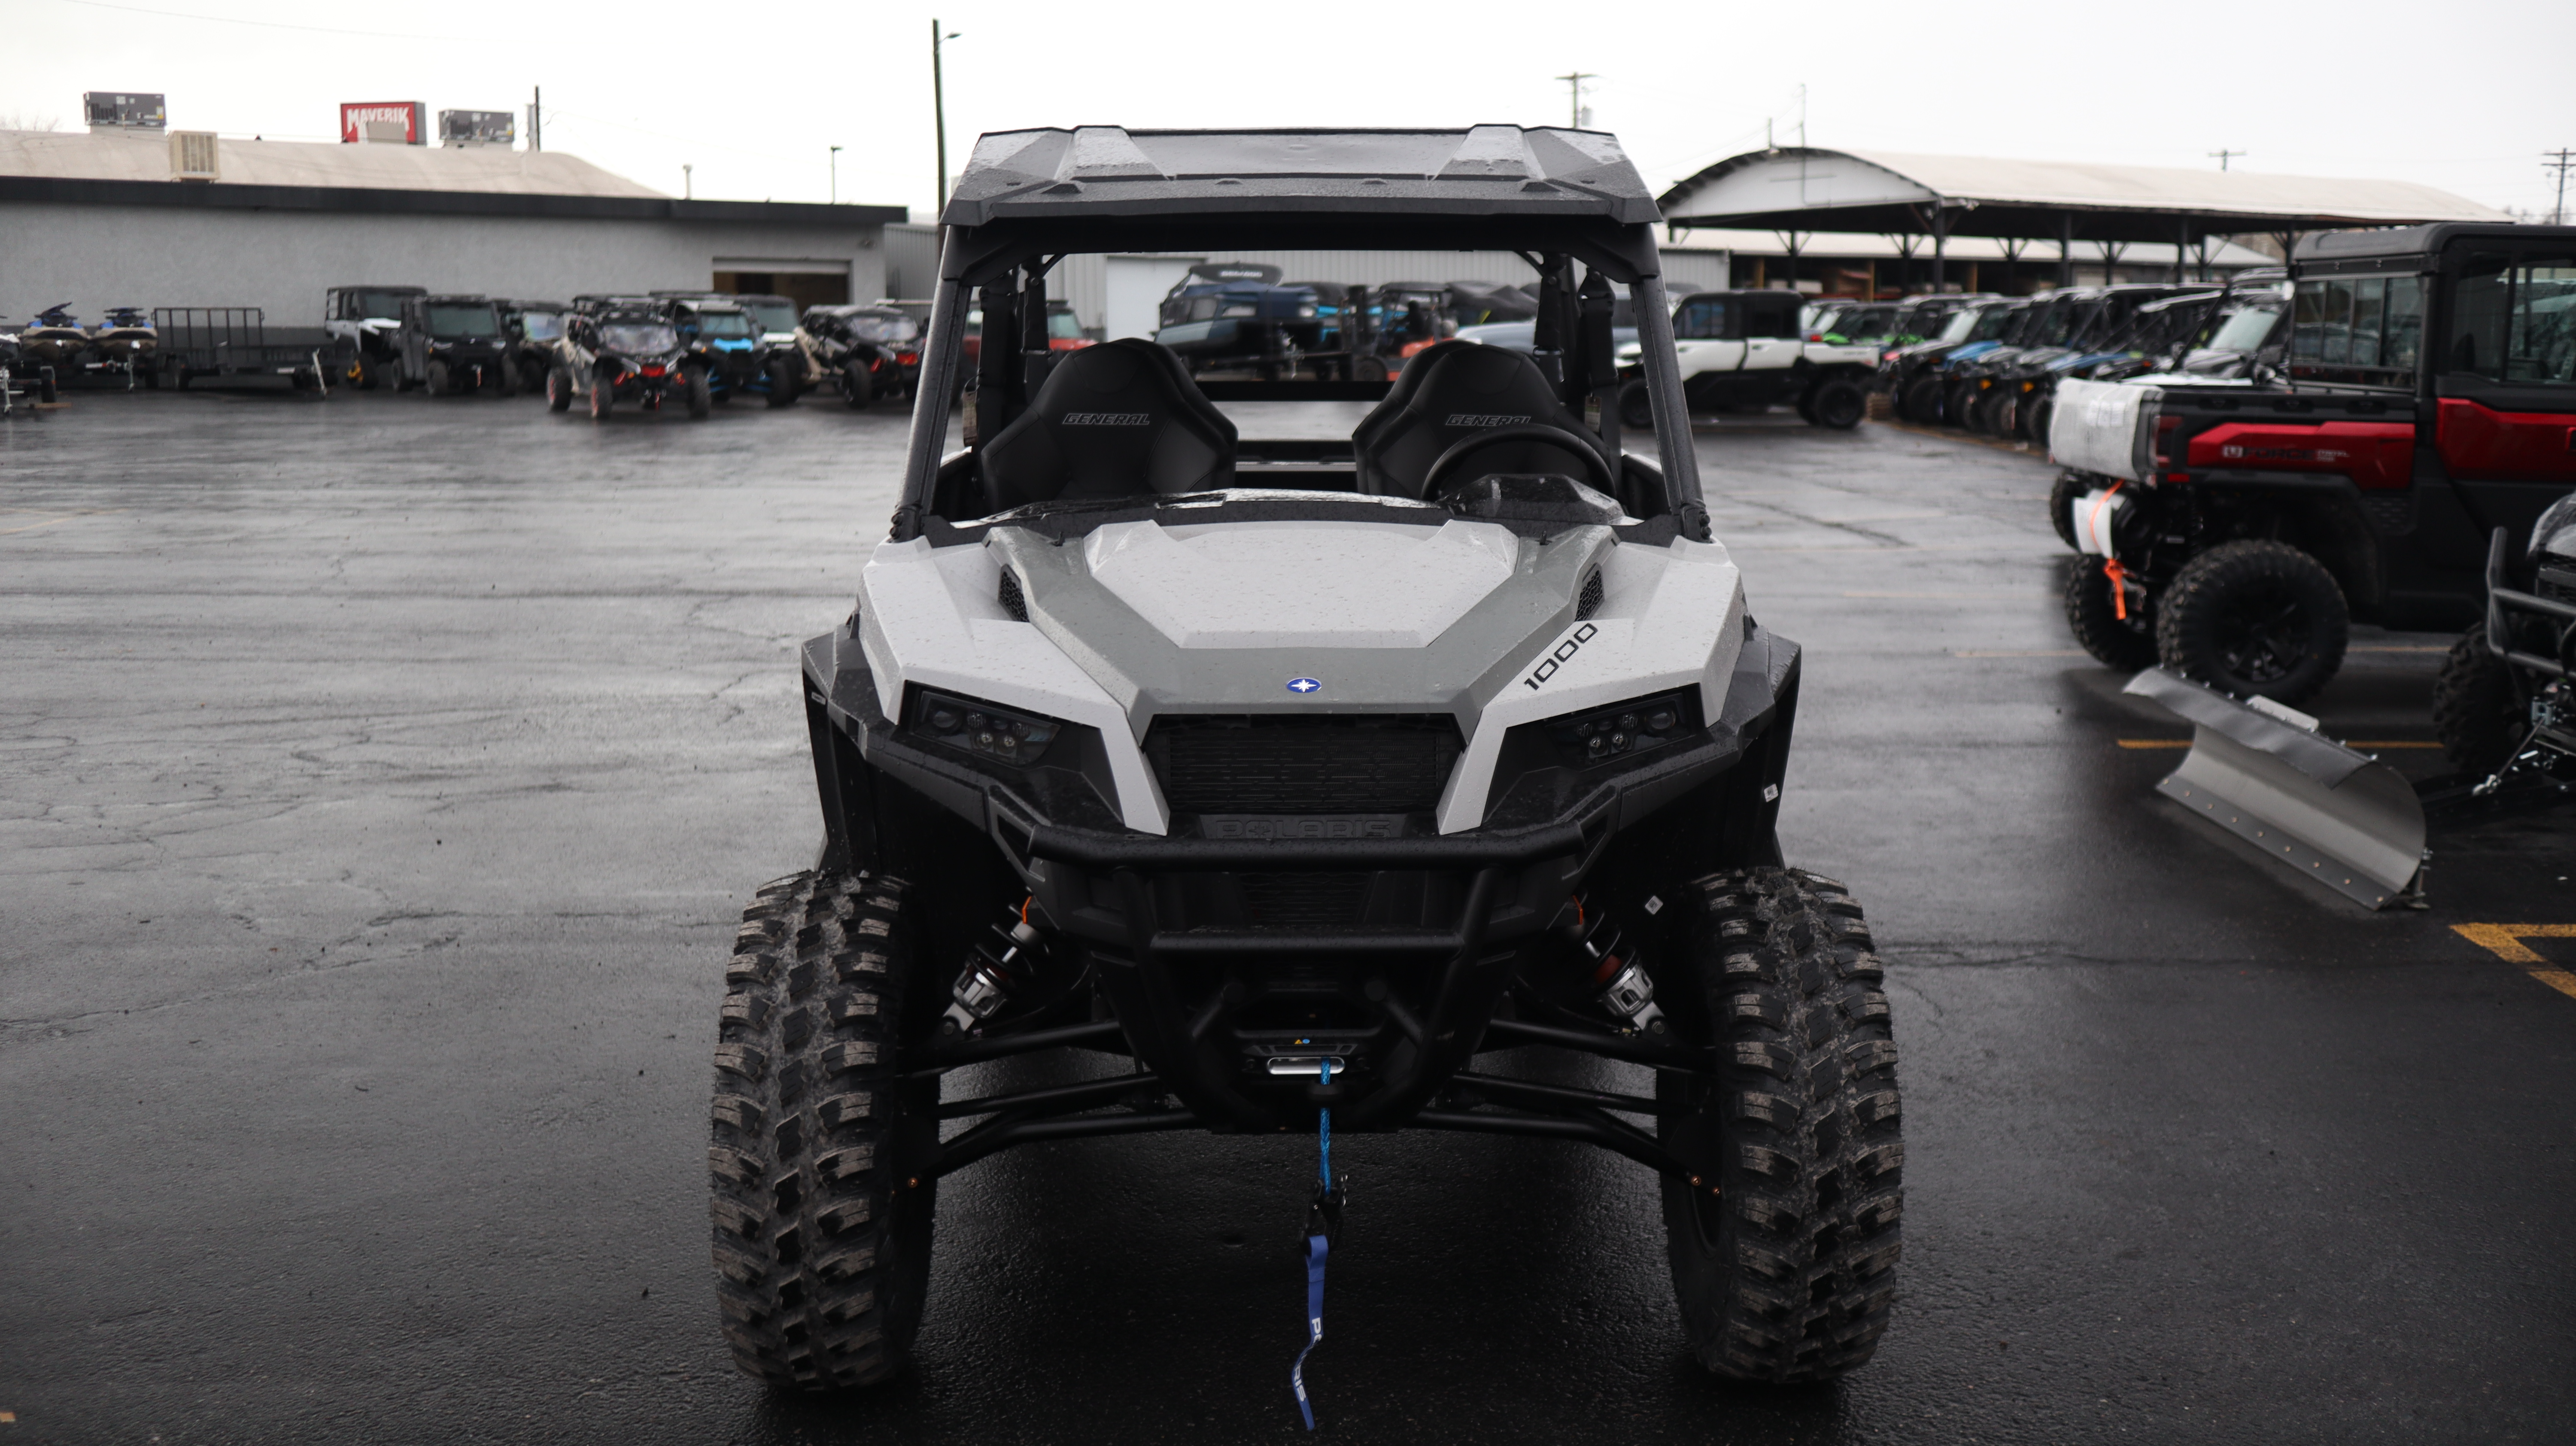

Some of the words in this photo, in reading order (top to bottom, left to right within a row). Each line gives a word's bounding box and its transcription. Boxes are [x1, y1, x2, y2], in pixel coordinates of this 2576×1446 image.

[346, 107, 410, 134] MAVERIK
[1062, 413, 1150, 425] GENERAL
[1524, 623, 1598, 691] 1000
[1216, 820, 1391, 838] POLARIS
[1294, 1317, 1322, 1402] PRIS
